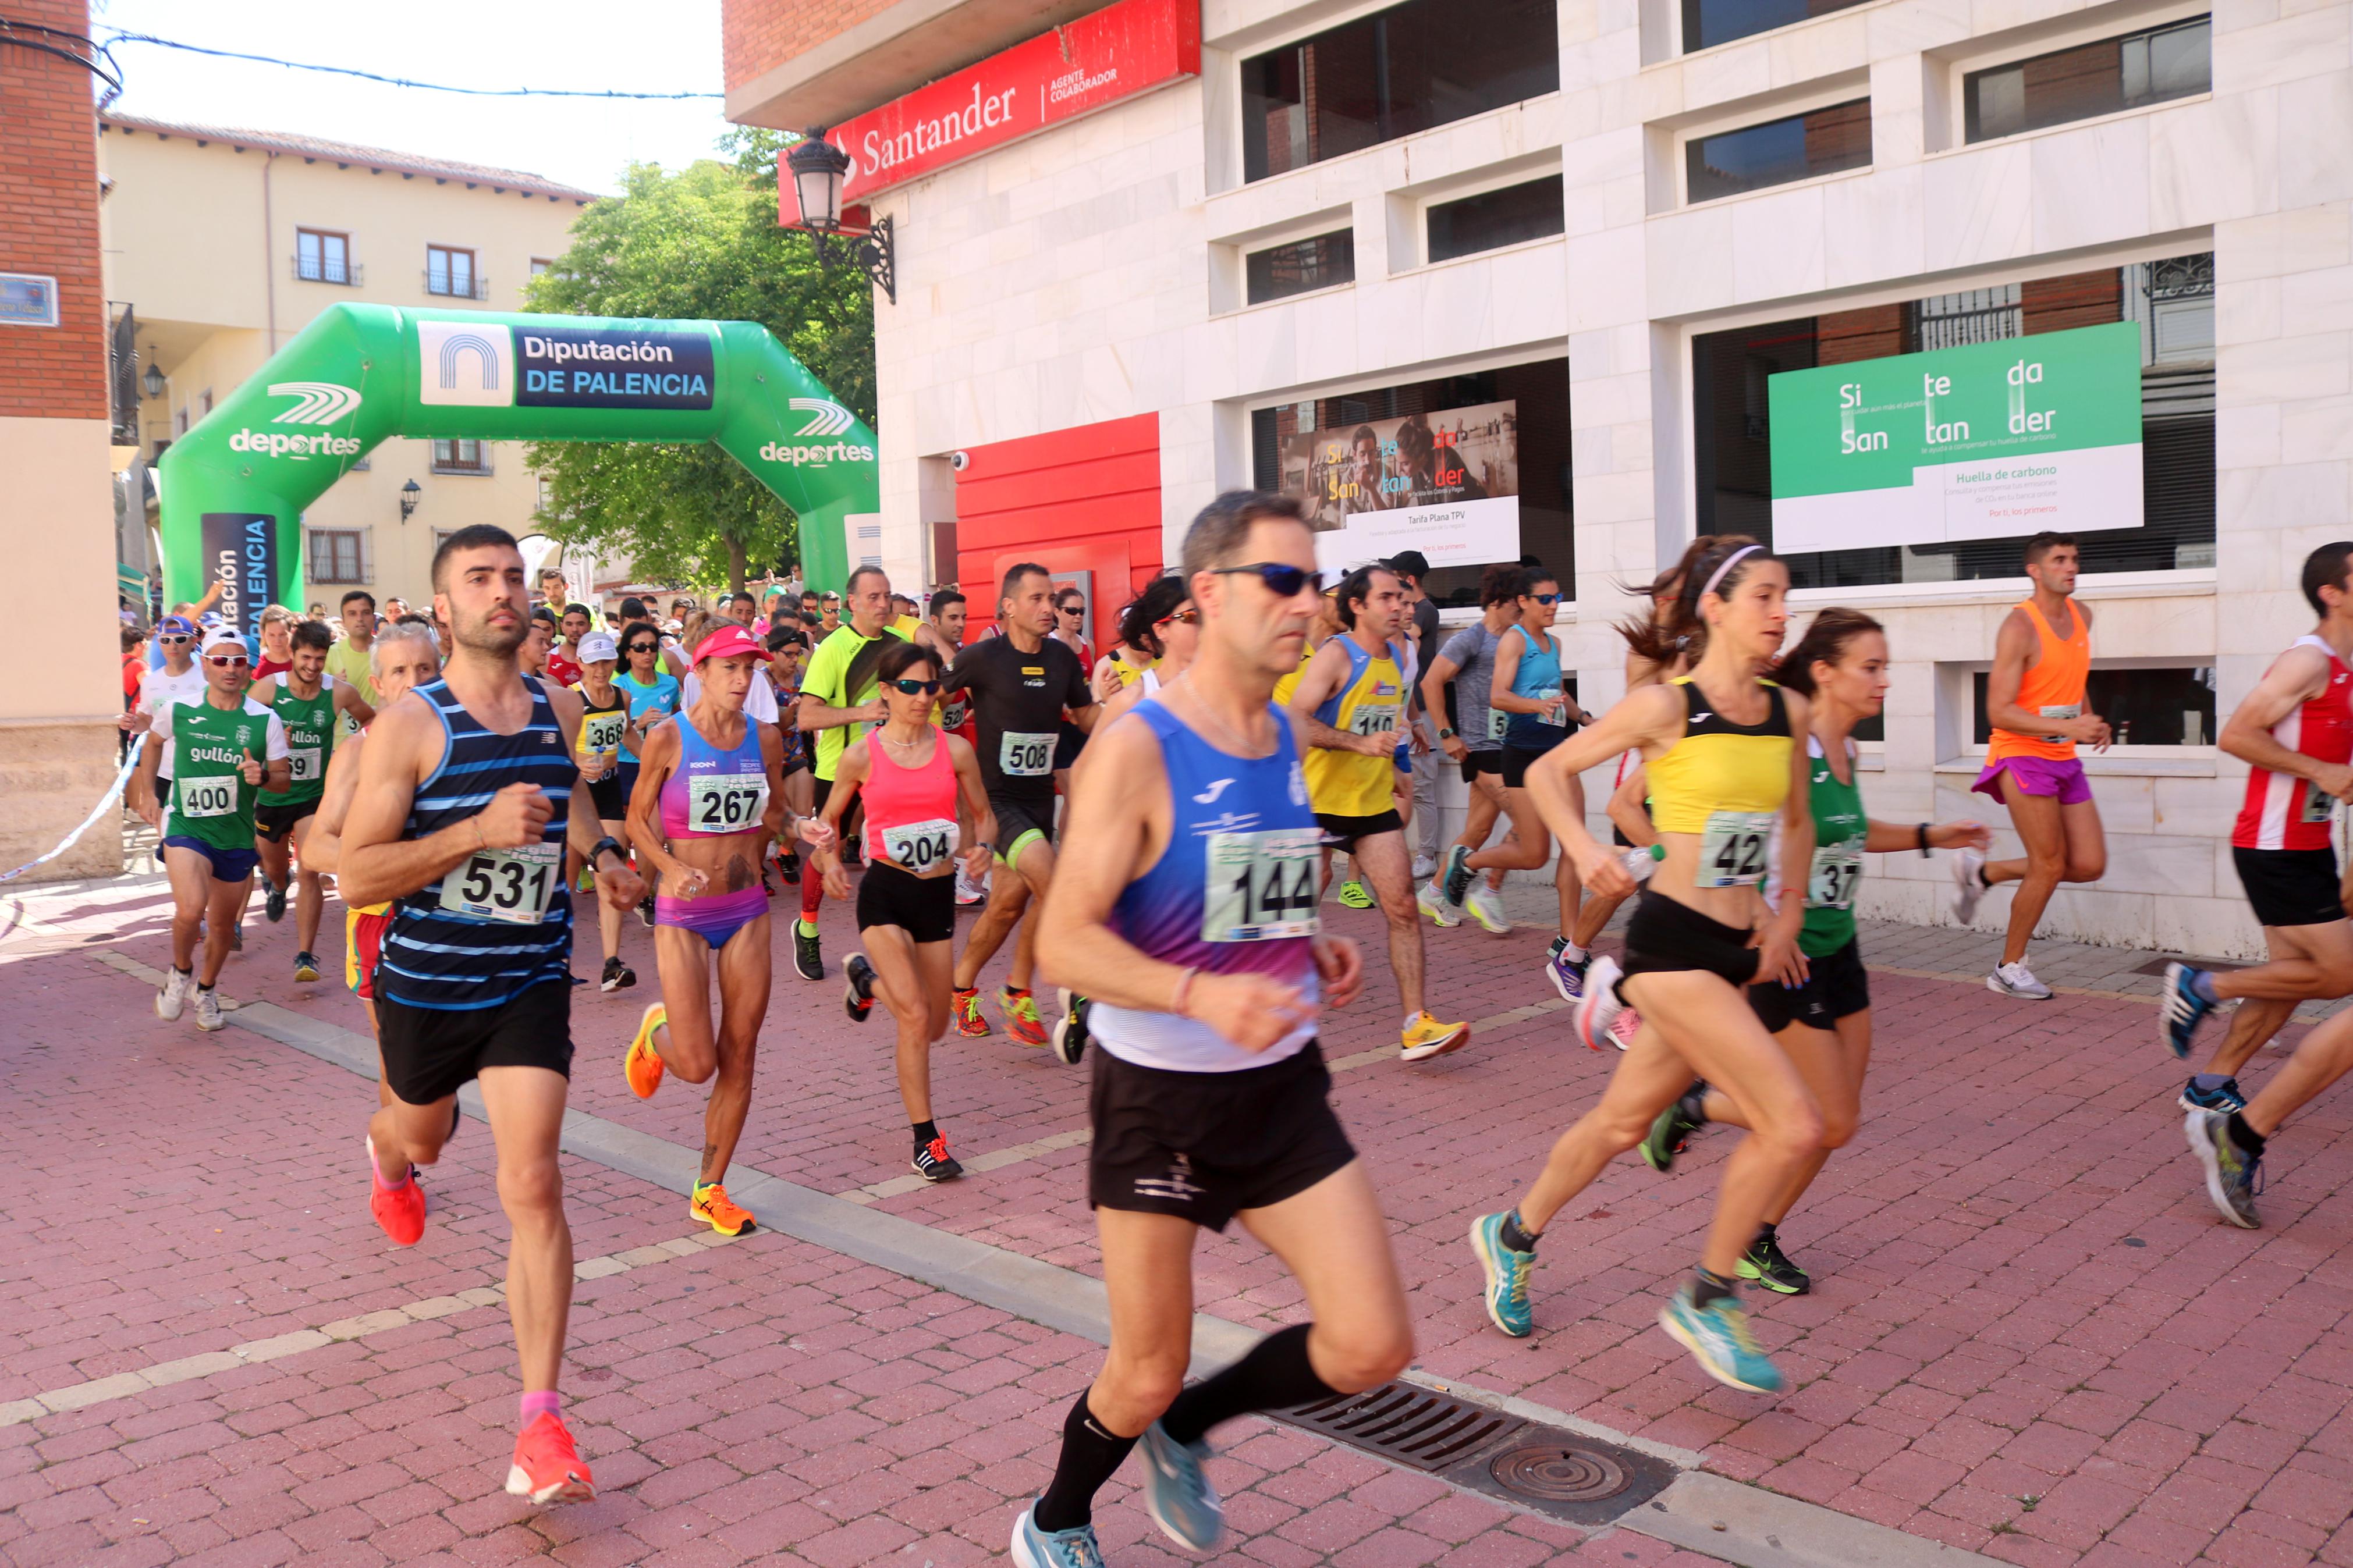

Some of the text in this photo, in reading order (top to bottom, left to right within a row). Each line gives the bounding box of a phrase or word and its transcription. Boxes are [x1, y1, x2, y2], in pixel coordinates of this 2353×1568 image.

[1050, 69, 1084, 92] AGENTE
[1050, 68, 1117, 103] COLABORADOR
[863, 81, 1016, 176] Santander
[524, 336, 673, 364] Diputación
[527, 370, 708, 396] DE PALENCIA
[1839, 359, 2043, 408] Si te da
[229, 428, 362, 457] deportes
[1841, 408, 2056, 454] San tan der
[1929, 445, 1947, 454] ayuda
[1954, 440, 1988, 451] compensar
[1998, 436, 2018, 445] huella
[2029, 432, 2057, 442] carbono
[759, 441, 874, 467] deportes
[1328, 428, 1457, 464] Si te da
[1329, 468, 1464, 500] San tan der
[1957, 466, 2057, 483] Huella de carbono
[1408, 511, 1465, 524] Tarifa Plana TPV
[2011, 507, 2022, 515] los
[2024, 505, 2058, 516] primeros
[215, 550, 239, 631] tación
[591, 723, 623, 746] 368
[190, 746, 243, 765] gullón
[1010, 745, 1048, 769] 508
[187, 787, 229, 810] 400
[701, 790, 759, 823] 267
[897, 833, 948, 867] 204
[462, 856, 548, 912] 531
[1231, 859, 1316, 924] 144
[1822, 865, 1861, 902] 37
